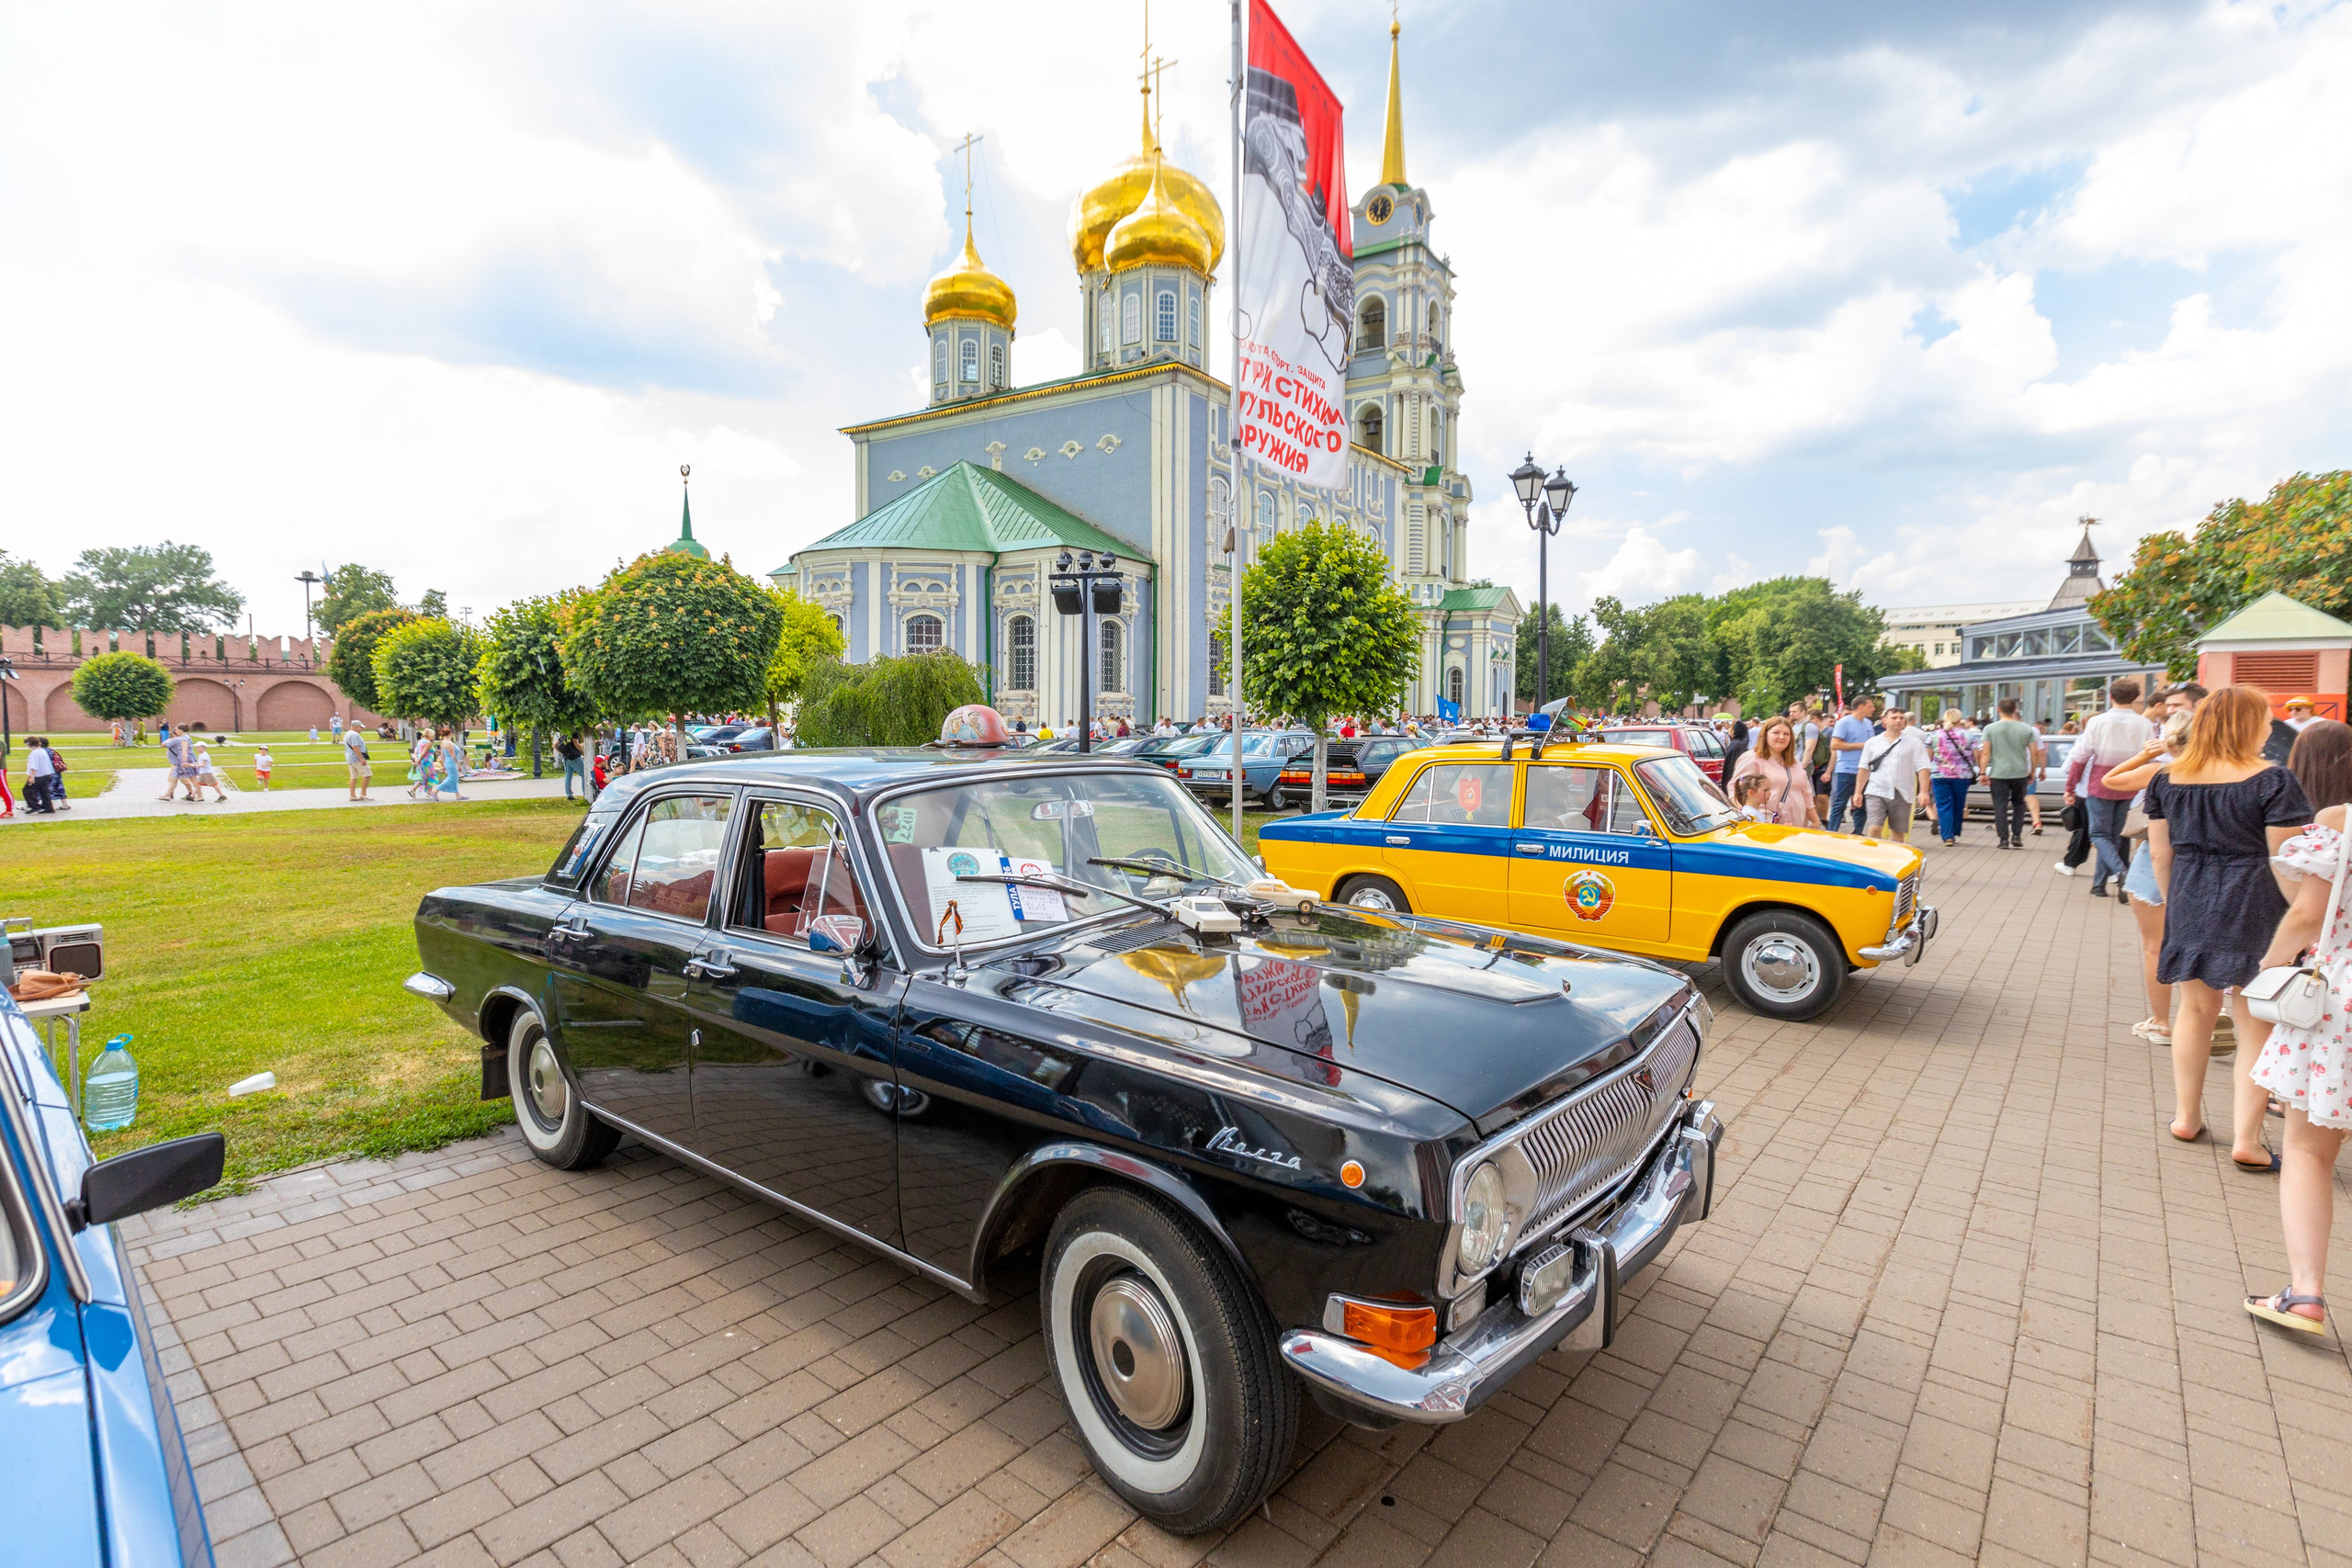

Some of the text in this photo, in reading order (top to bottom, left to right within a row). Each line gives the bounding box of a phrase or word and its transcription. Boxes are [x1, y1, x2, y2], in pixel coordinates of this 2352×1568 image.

[1239, 356, 1272, 393] ТРИ
[1296, 365, 1326, 391] ЗАЩИТА
[900, 811, 914, 841] 1977
[1549, 845, 1629, 863] МИЛИЦИЯ
[1008, 886, 1022, 910] ТУЛА
